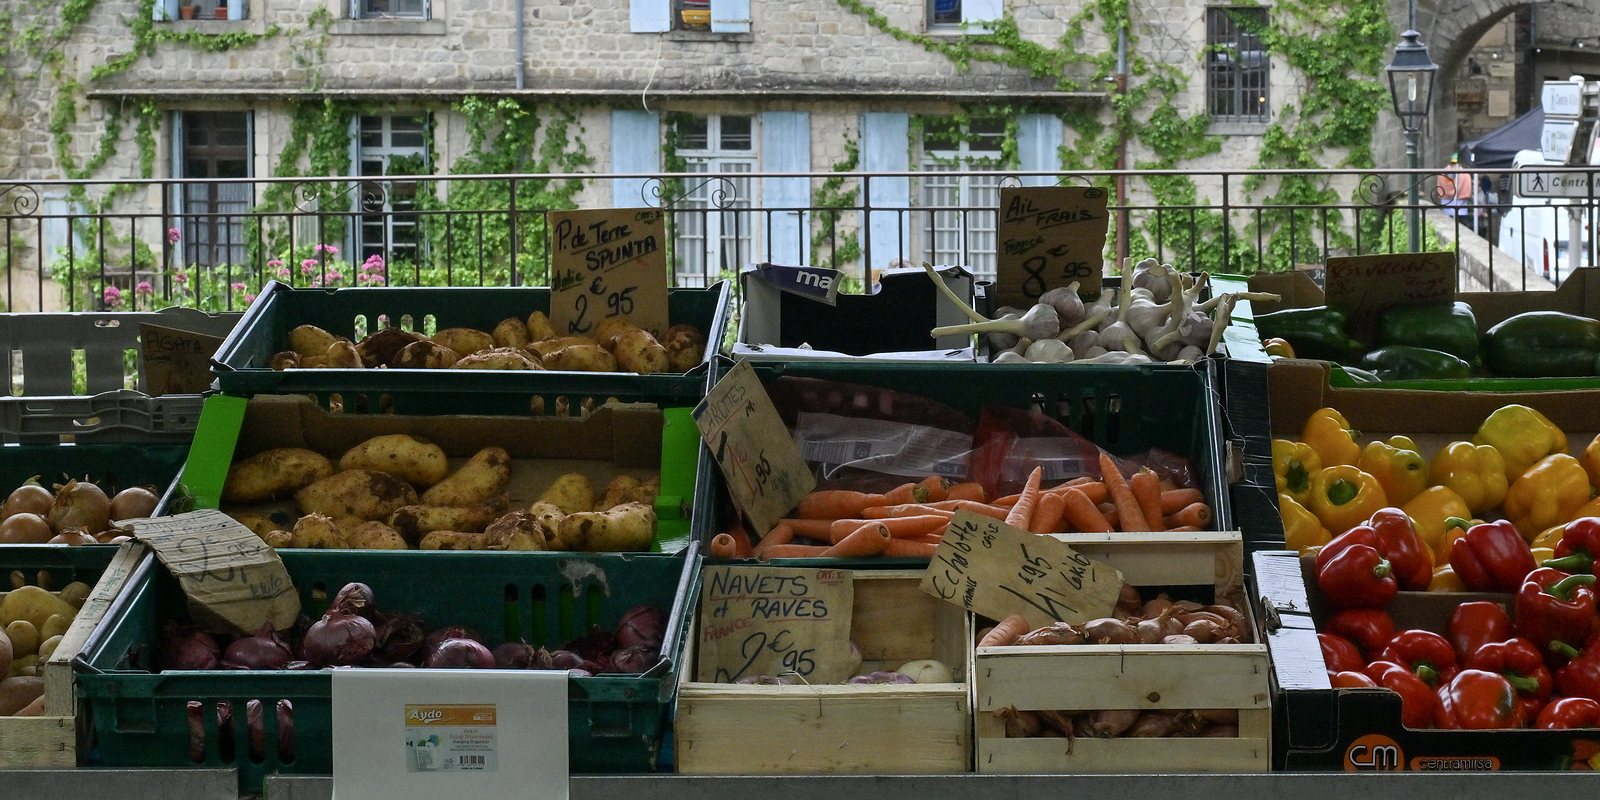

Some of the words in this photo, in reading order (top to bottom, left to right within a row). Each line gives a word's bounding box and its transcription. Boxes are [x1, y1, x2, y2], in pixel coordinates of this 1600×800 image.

[588, 220, 633, 244] Terre
[585, 235, 658, 272] SPUNTA
[1022, 255, 1047, 298] 8
[568, 293, 593, 335] 2
[605, 285, 639, 319] 95
[709, 567, 808, 597] NAVETS
[713, 599, 729, 618] et
[751, 597, 828, 619] RAVES
[703, 618, 752, 643] FRANCE
[777, 648, 816, 678] 95
[1350, 745, 1398, 767] cm
